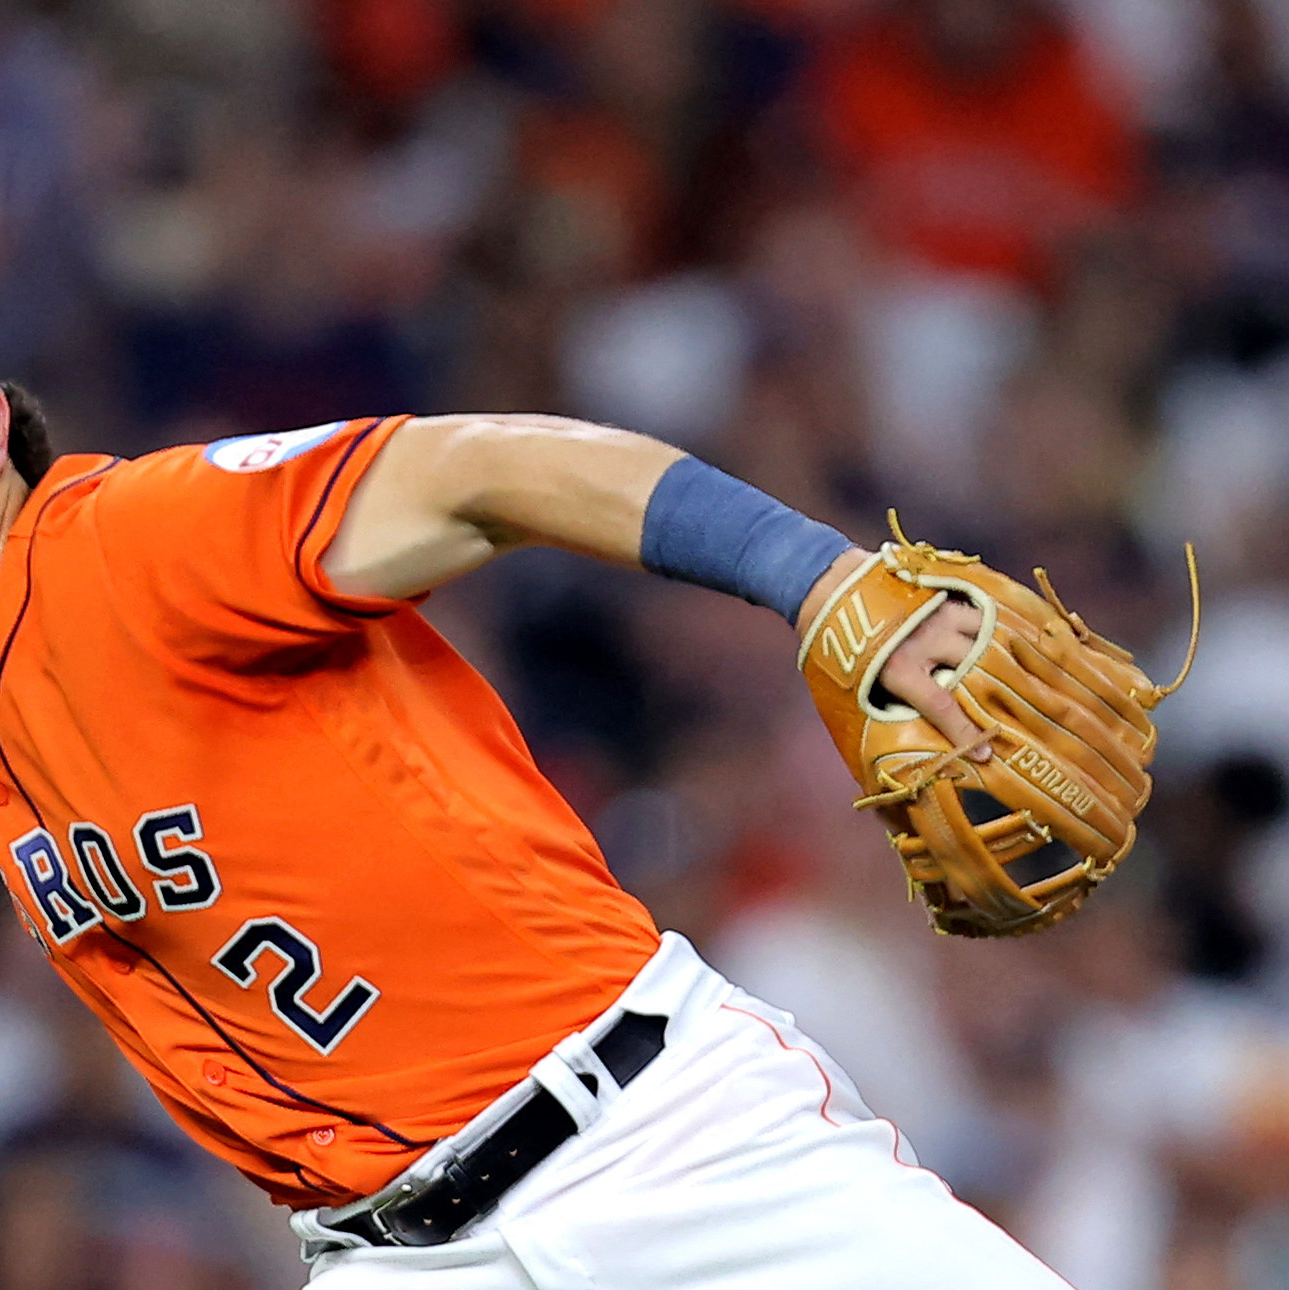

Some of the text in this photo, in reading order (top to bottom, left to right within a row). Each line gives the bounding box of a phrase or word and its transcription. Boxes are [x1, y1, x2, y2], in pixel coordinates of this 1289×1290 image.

[1005, 744, 1095, 816] marucci
[10, 803, 222, 946] ROS
[211, 916, 381, 1056] 2
